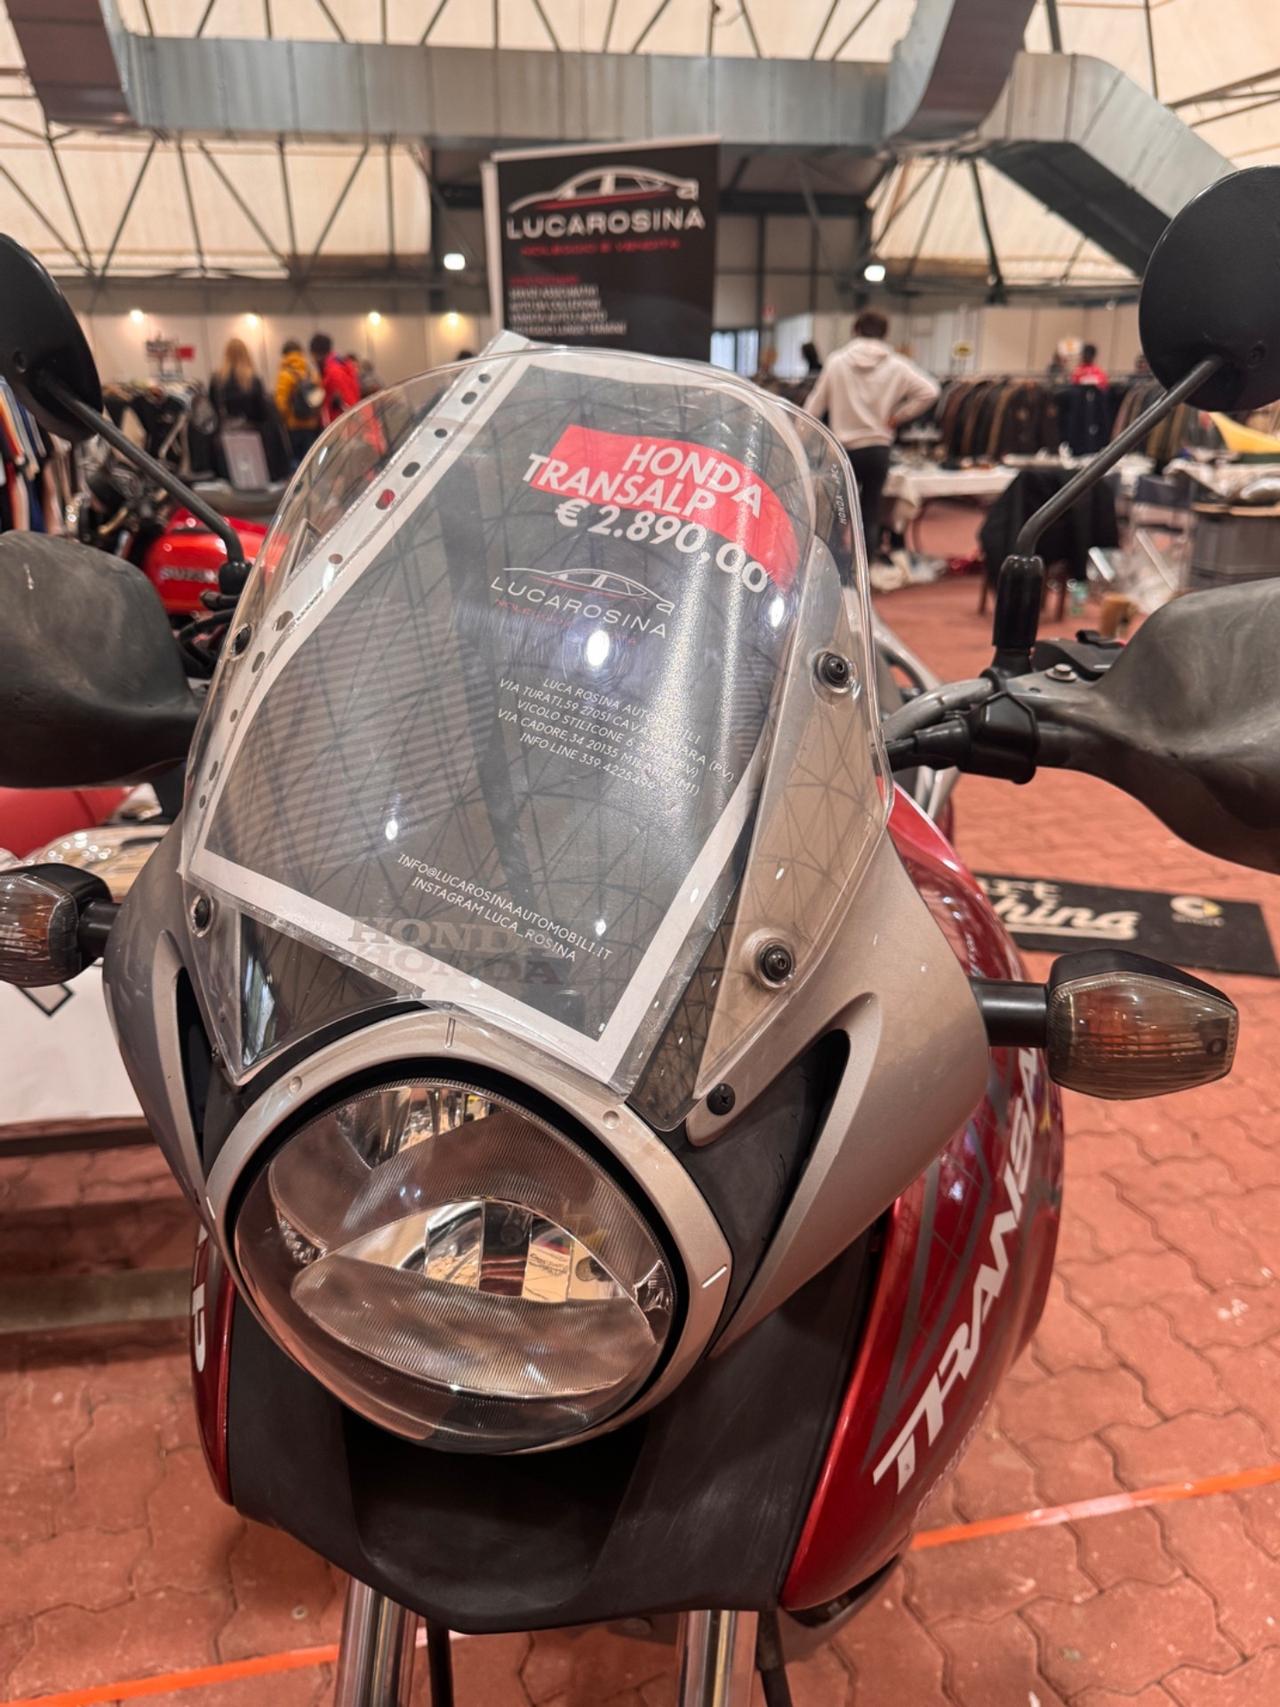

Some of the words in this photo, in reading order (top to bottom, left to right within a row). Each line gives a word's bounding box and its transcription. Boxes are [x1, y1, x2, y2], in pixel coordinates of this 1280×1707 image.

[506, 207, 705, 239] LUCAROSINA
[522, 453, 716, 517] TRANSALP
[622, 443, 762, 519] HONDA
[555, 498, 590, 528] €
[588, 505, 769, 593] 2.890,00
[490, 576, 667, 639] LUCAROSINA
[517, 699, 561, 722] VICOLO
[562, 714, 625, 744] STILICONE
[543, 678, 574, 696] LUCA
[574, 688, 620, 710] ROSINA
[497, 708, 518, 724] VIA
[588, 738, 619, 757] 20135
[499, 678, 520, 694] VIA
[580, 704, 612, 722] 27051
[708, 761, 735, 784] (PV)
[520, 732, 549, 750] INFO
[550, 742, 578, 761] LINE
[398, 854, 613, 960] INFO@LUCAROSINAAUTOMOBILI.IT
[411, 876, 484, 916] INSTAGRAM
[483, 909, 576, 962] LUCA_ROSINA
